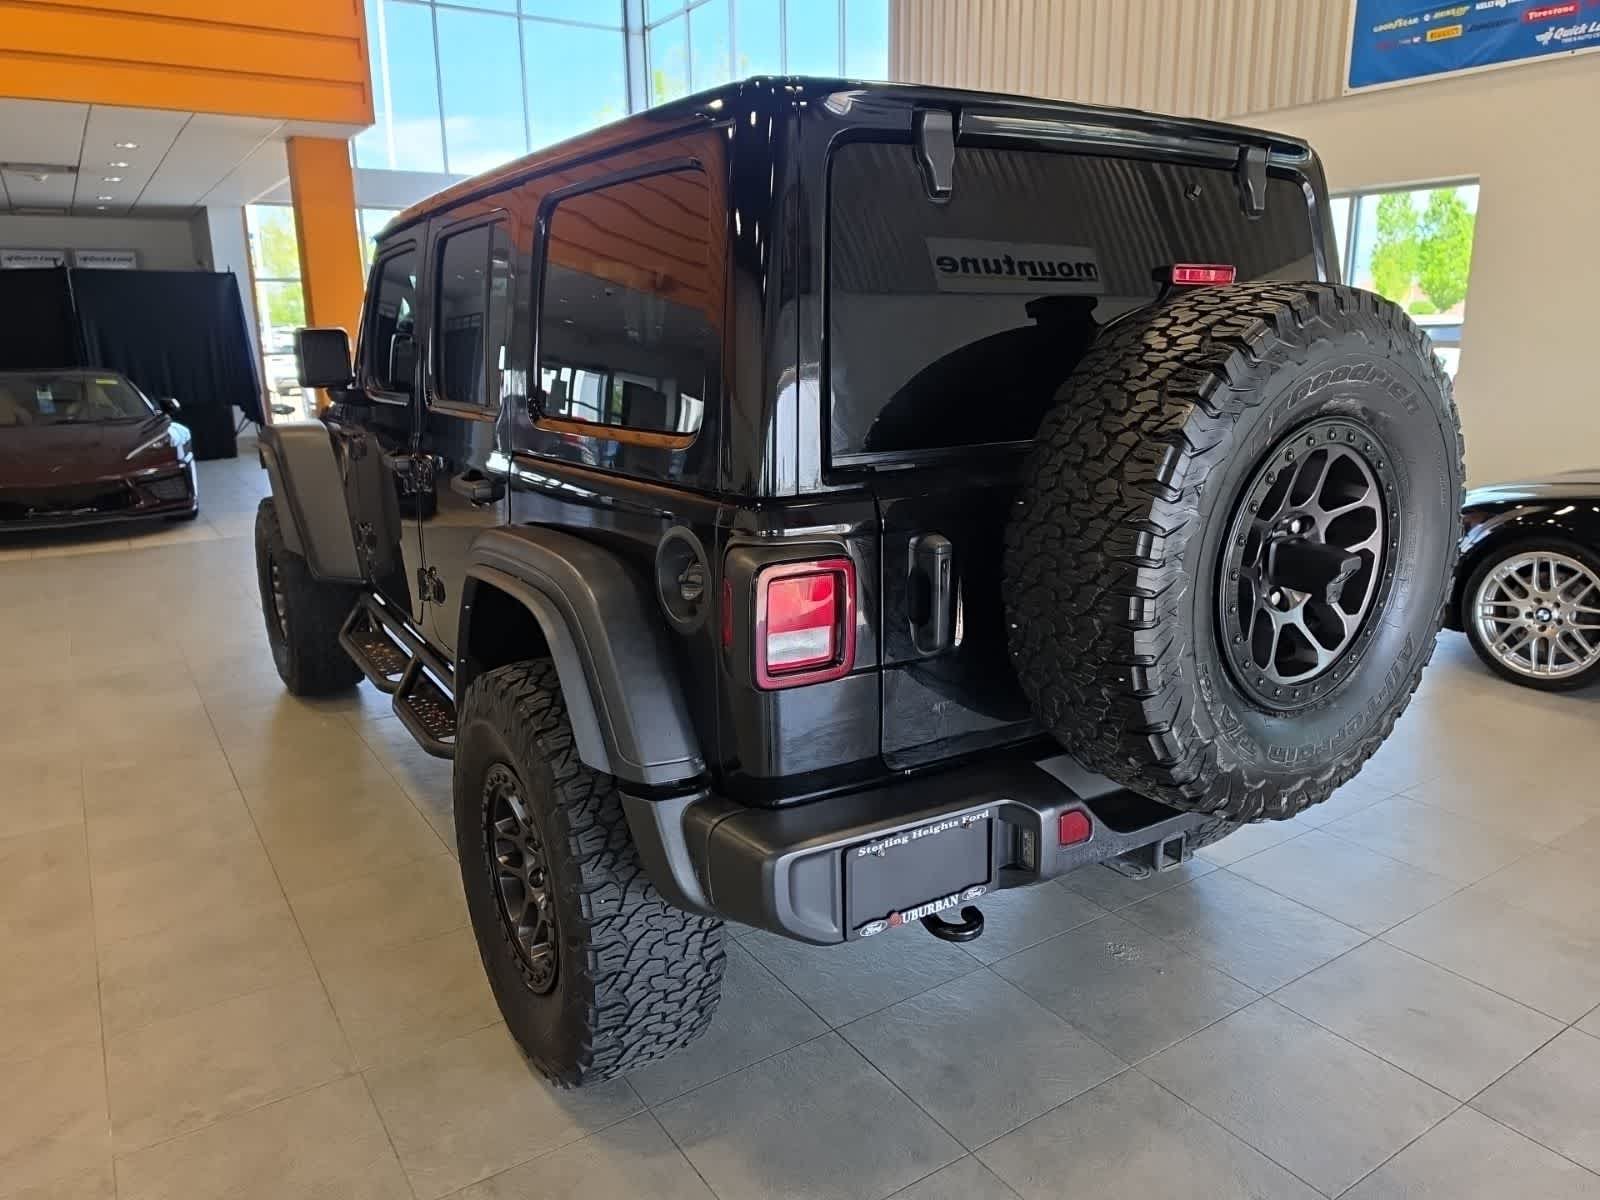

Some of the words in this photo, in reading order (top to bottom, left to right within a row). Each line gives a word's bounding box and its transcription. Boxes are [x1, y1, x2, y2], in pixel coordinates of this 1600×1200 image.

[1528, 5, 1575, 21] Firestone
[1553, 23, 1588, 40] Quick
[858, 835, 909, 856] Sterling
[912, 819, 959, 840] Heights
[961, 809, 990, 824] Ford
